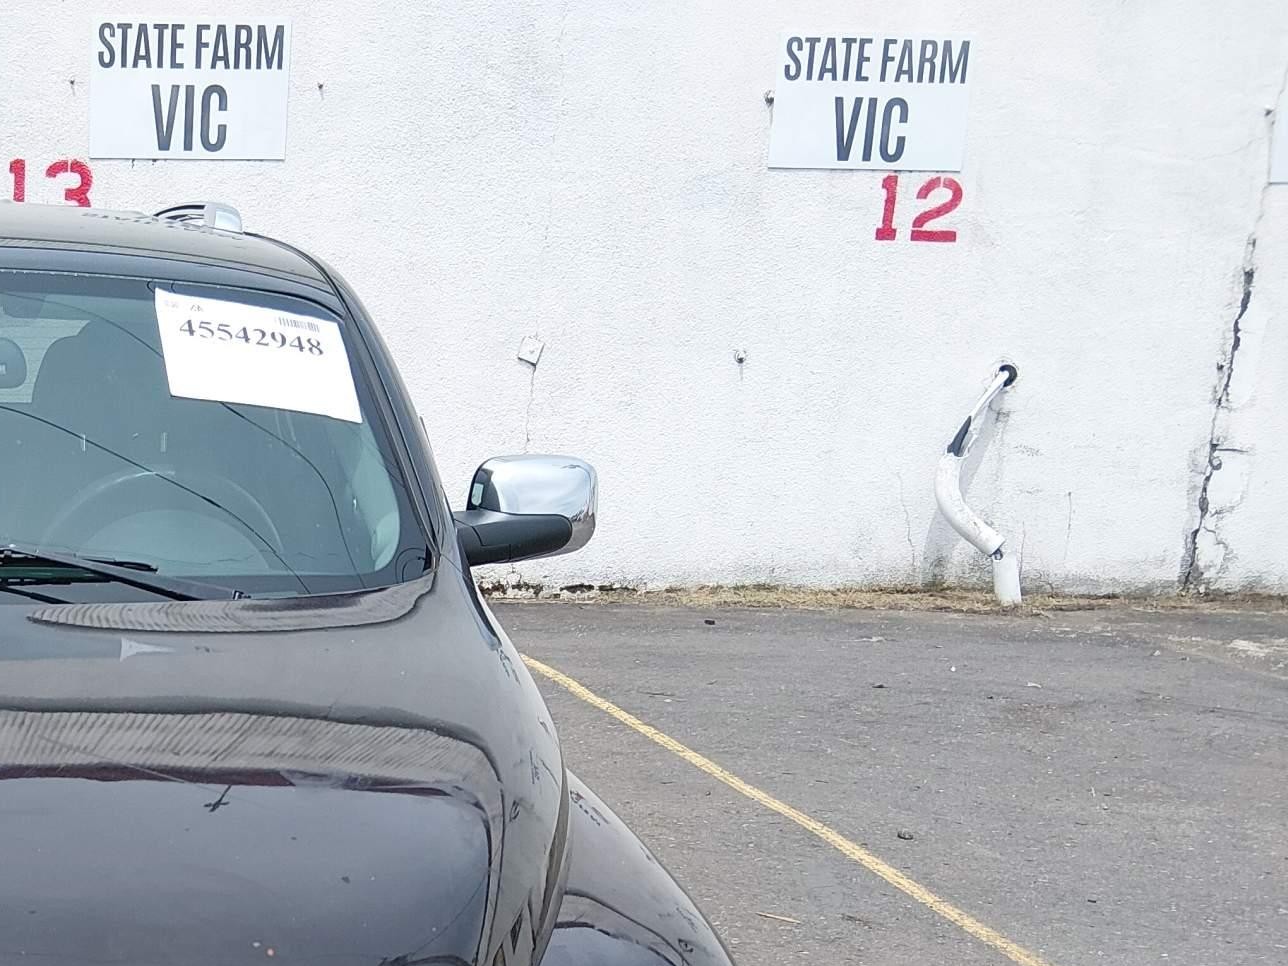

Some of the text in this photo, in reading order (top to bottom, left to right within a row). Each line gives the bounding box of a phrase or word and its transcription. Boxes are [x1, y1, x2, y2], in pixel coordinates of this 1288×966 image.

[98, 23, 285, 70] STATE FARM
[784, 37, 971, 84] STATE FARM
[151, 84, 228, 152] VIC
[835, 96, 909, 163] VIC
[9, 158, 94, 208] 13
[875, 175, 963, 243] 12
[179, 319, 324, 356] 45542948
